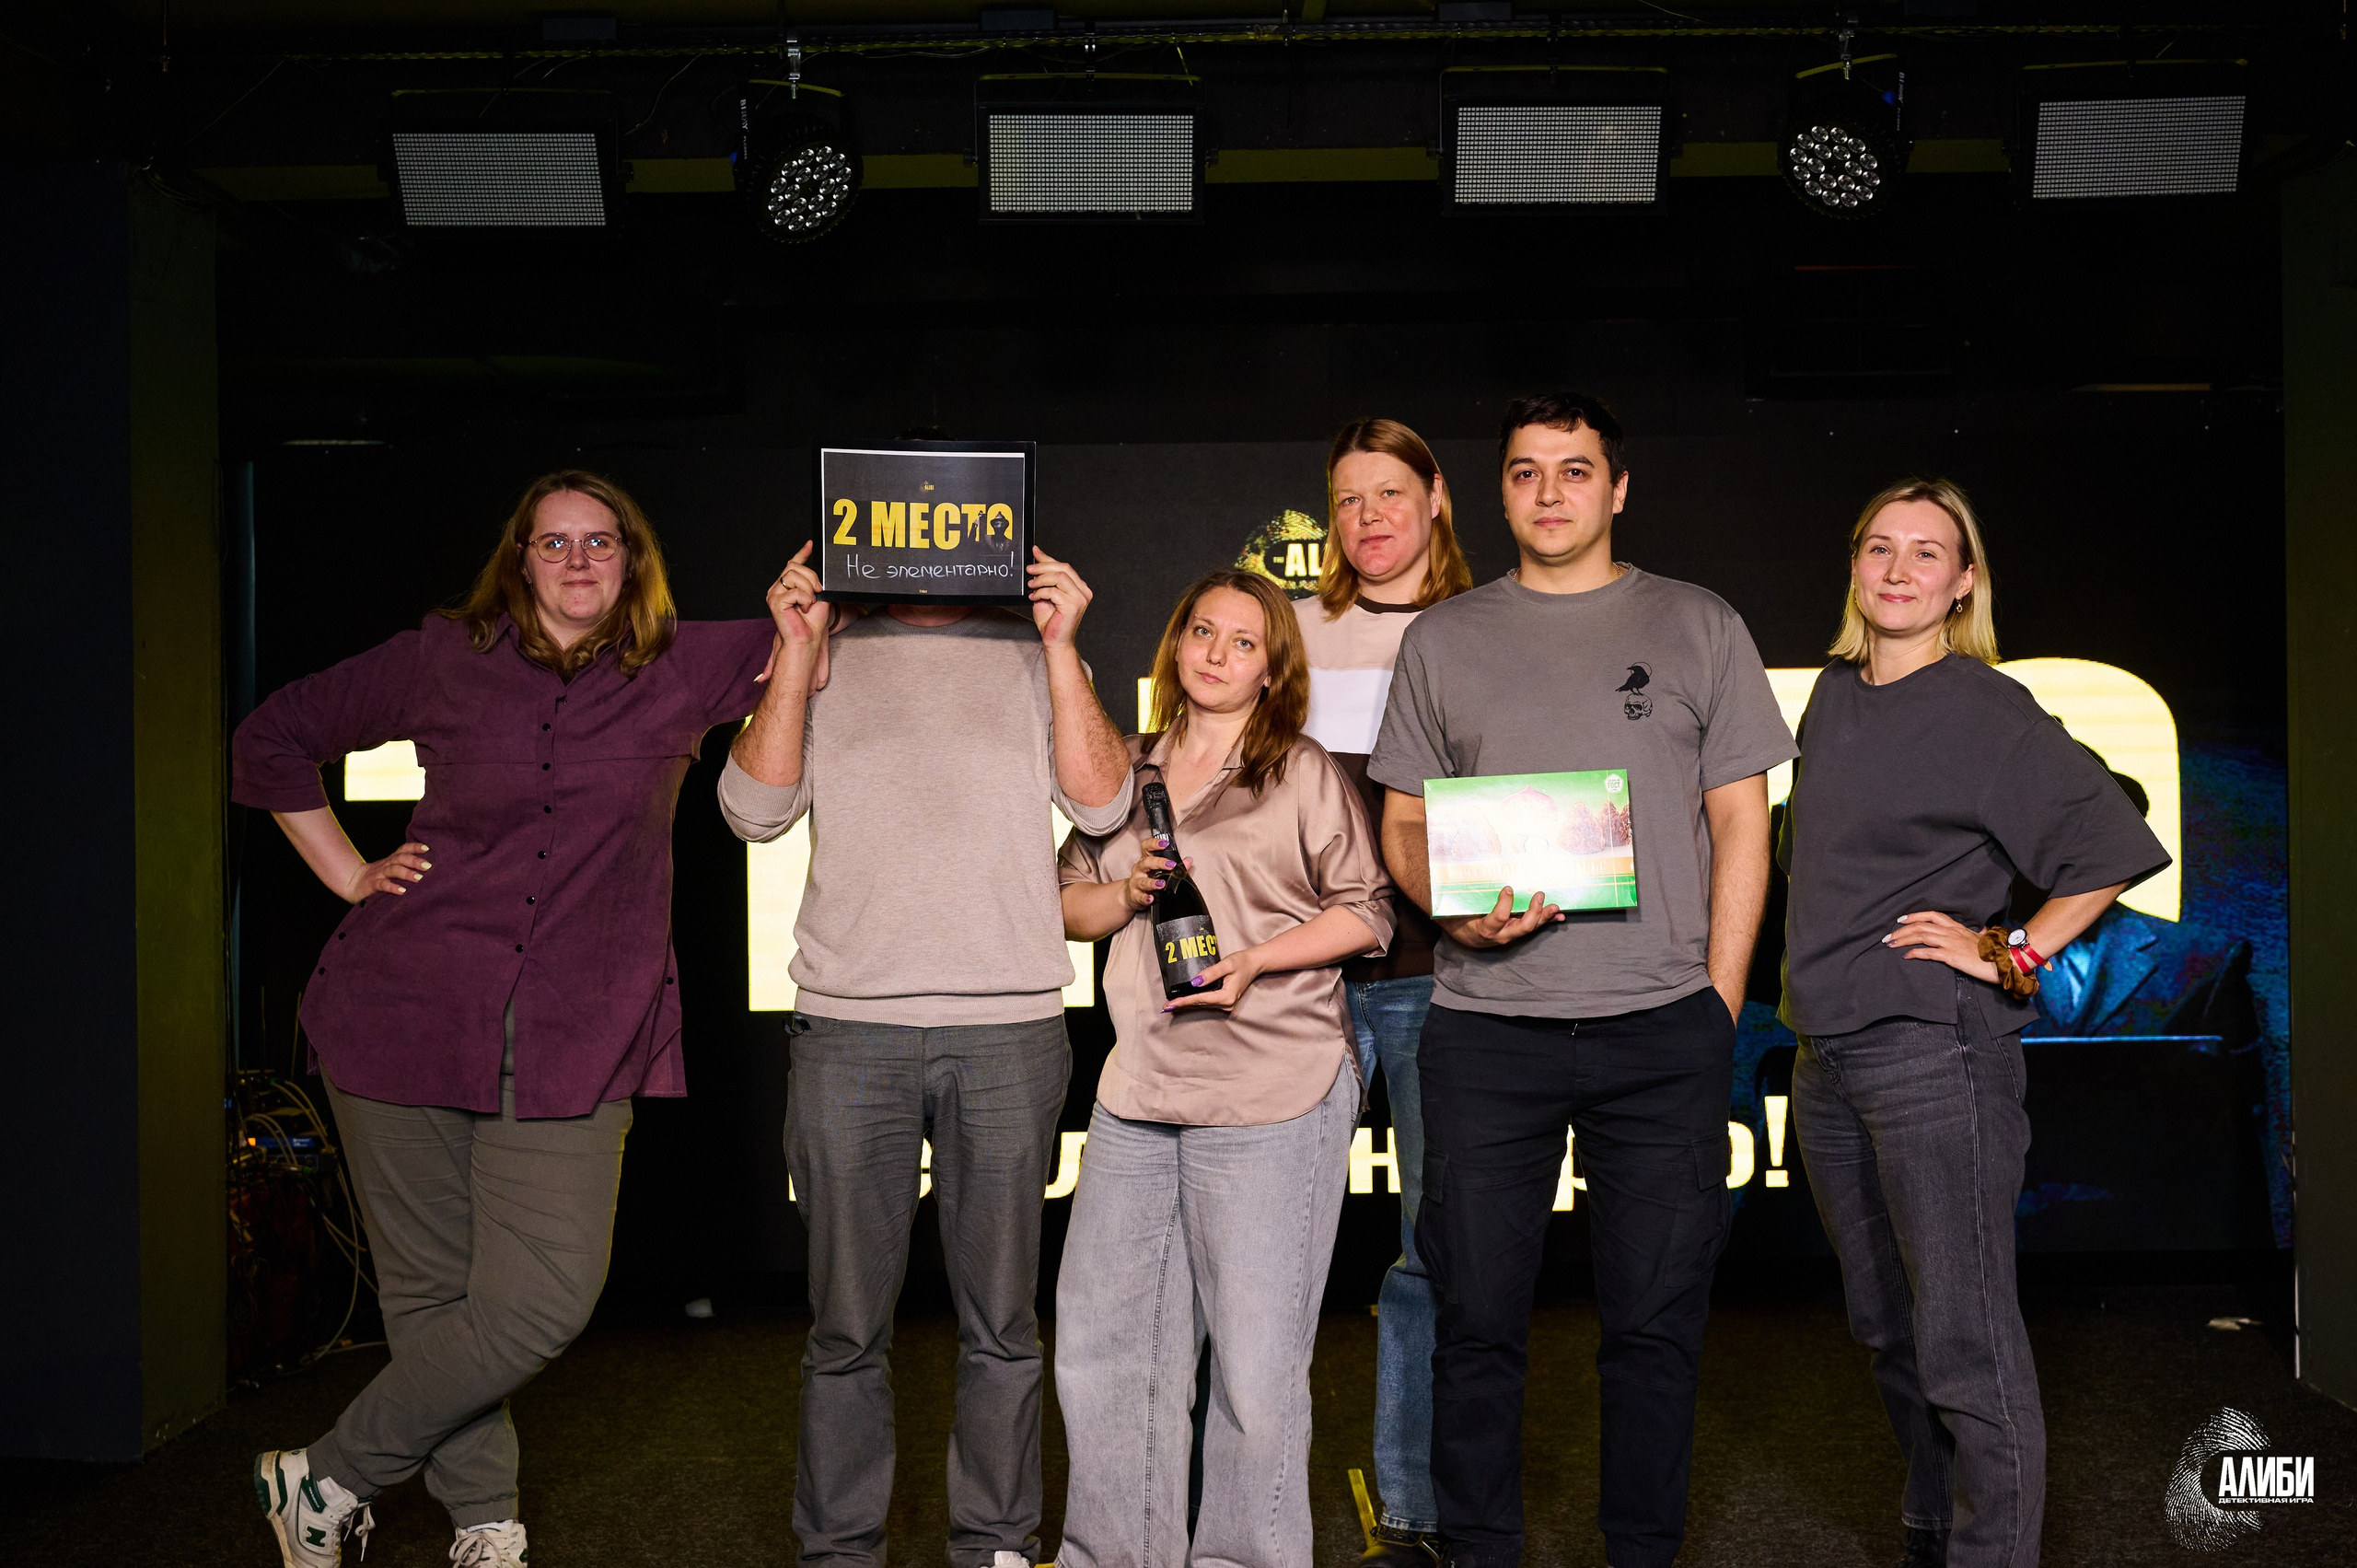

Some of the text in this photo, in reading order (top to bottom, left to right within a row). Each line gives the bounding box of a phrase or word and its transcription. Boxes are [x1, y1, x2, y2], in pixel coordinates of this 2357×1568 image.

[832, 498, 1014, 551] 2 МЕСТО
[847, 551, 1015, 579] Не элементарно!
[1165, 941, 1178, 964] 2
